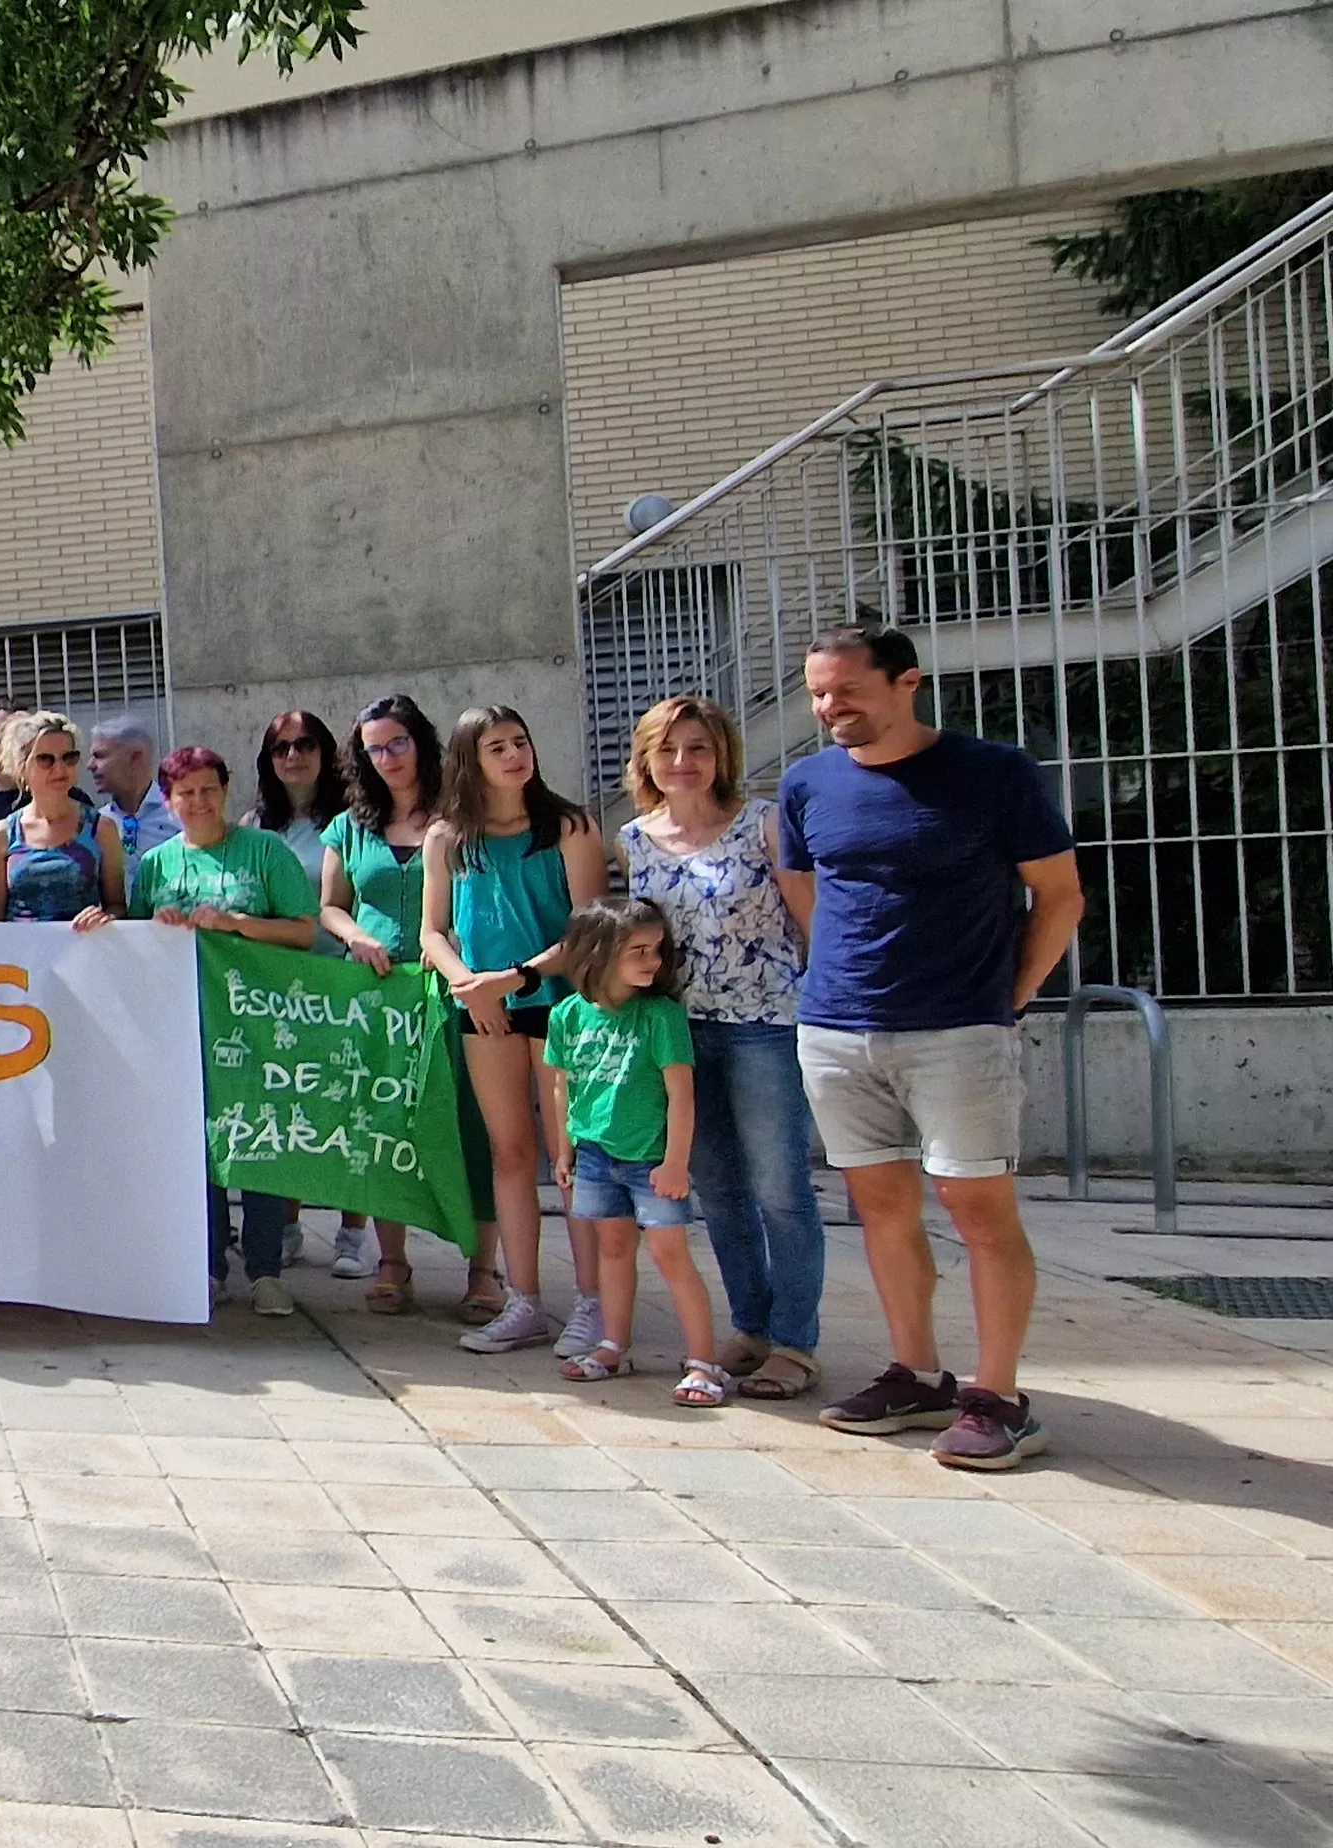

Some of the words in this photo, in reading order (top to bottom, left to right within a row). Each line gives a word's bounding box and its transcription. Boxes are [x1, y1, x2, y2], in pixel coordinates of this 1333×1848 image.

[228, 985, 370, 1034] ESCUELA
[263, 1061, 321, 1093] DE
[227, 1121, 351, 1158] PARA
